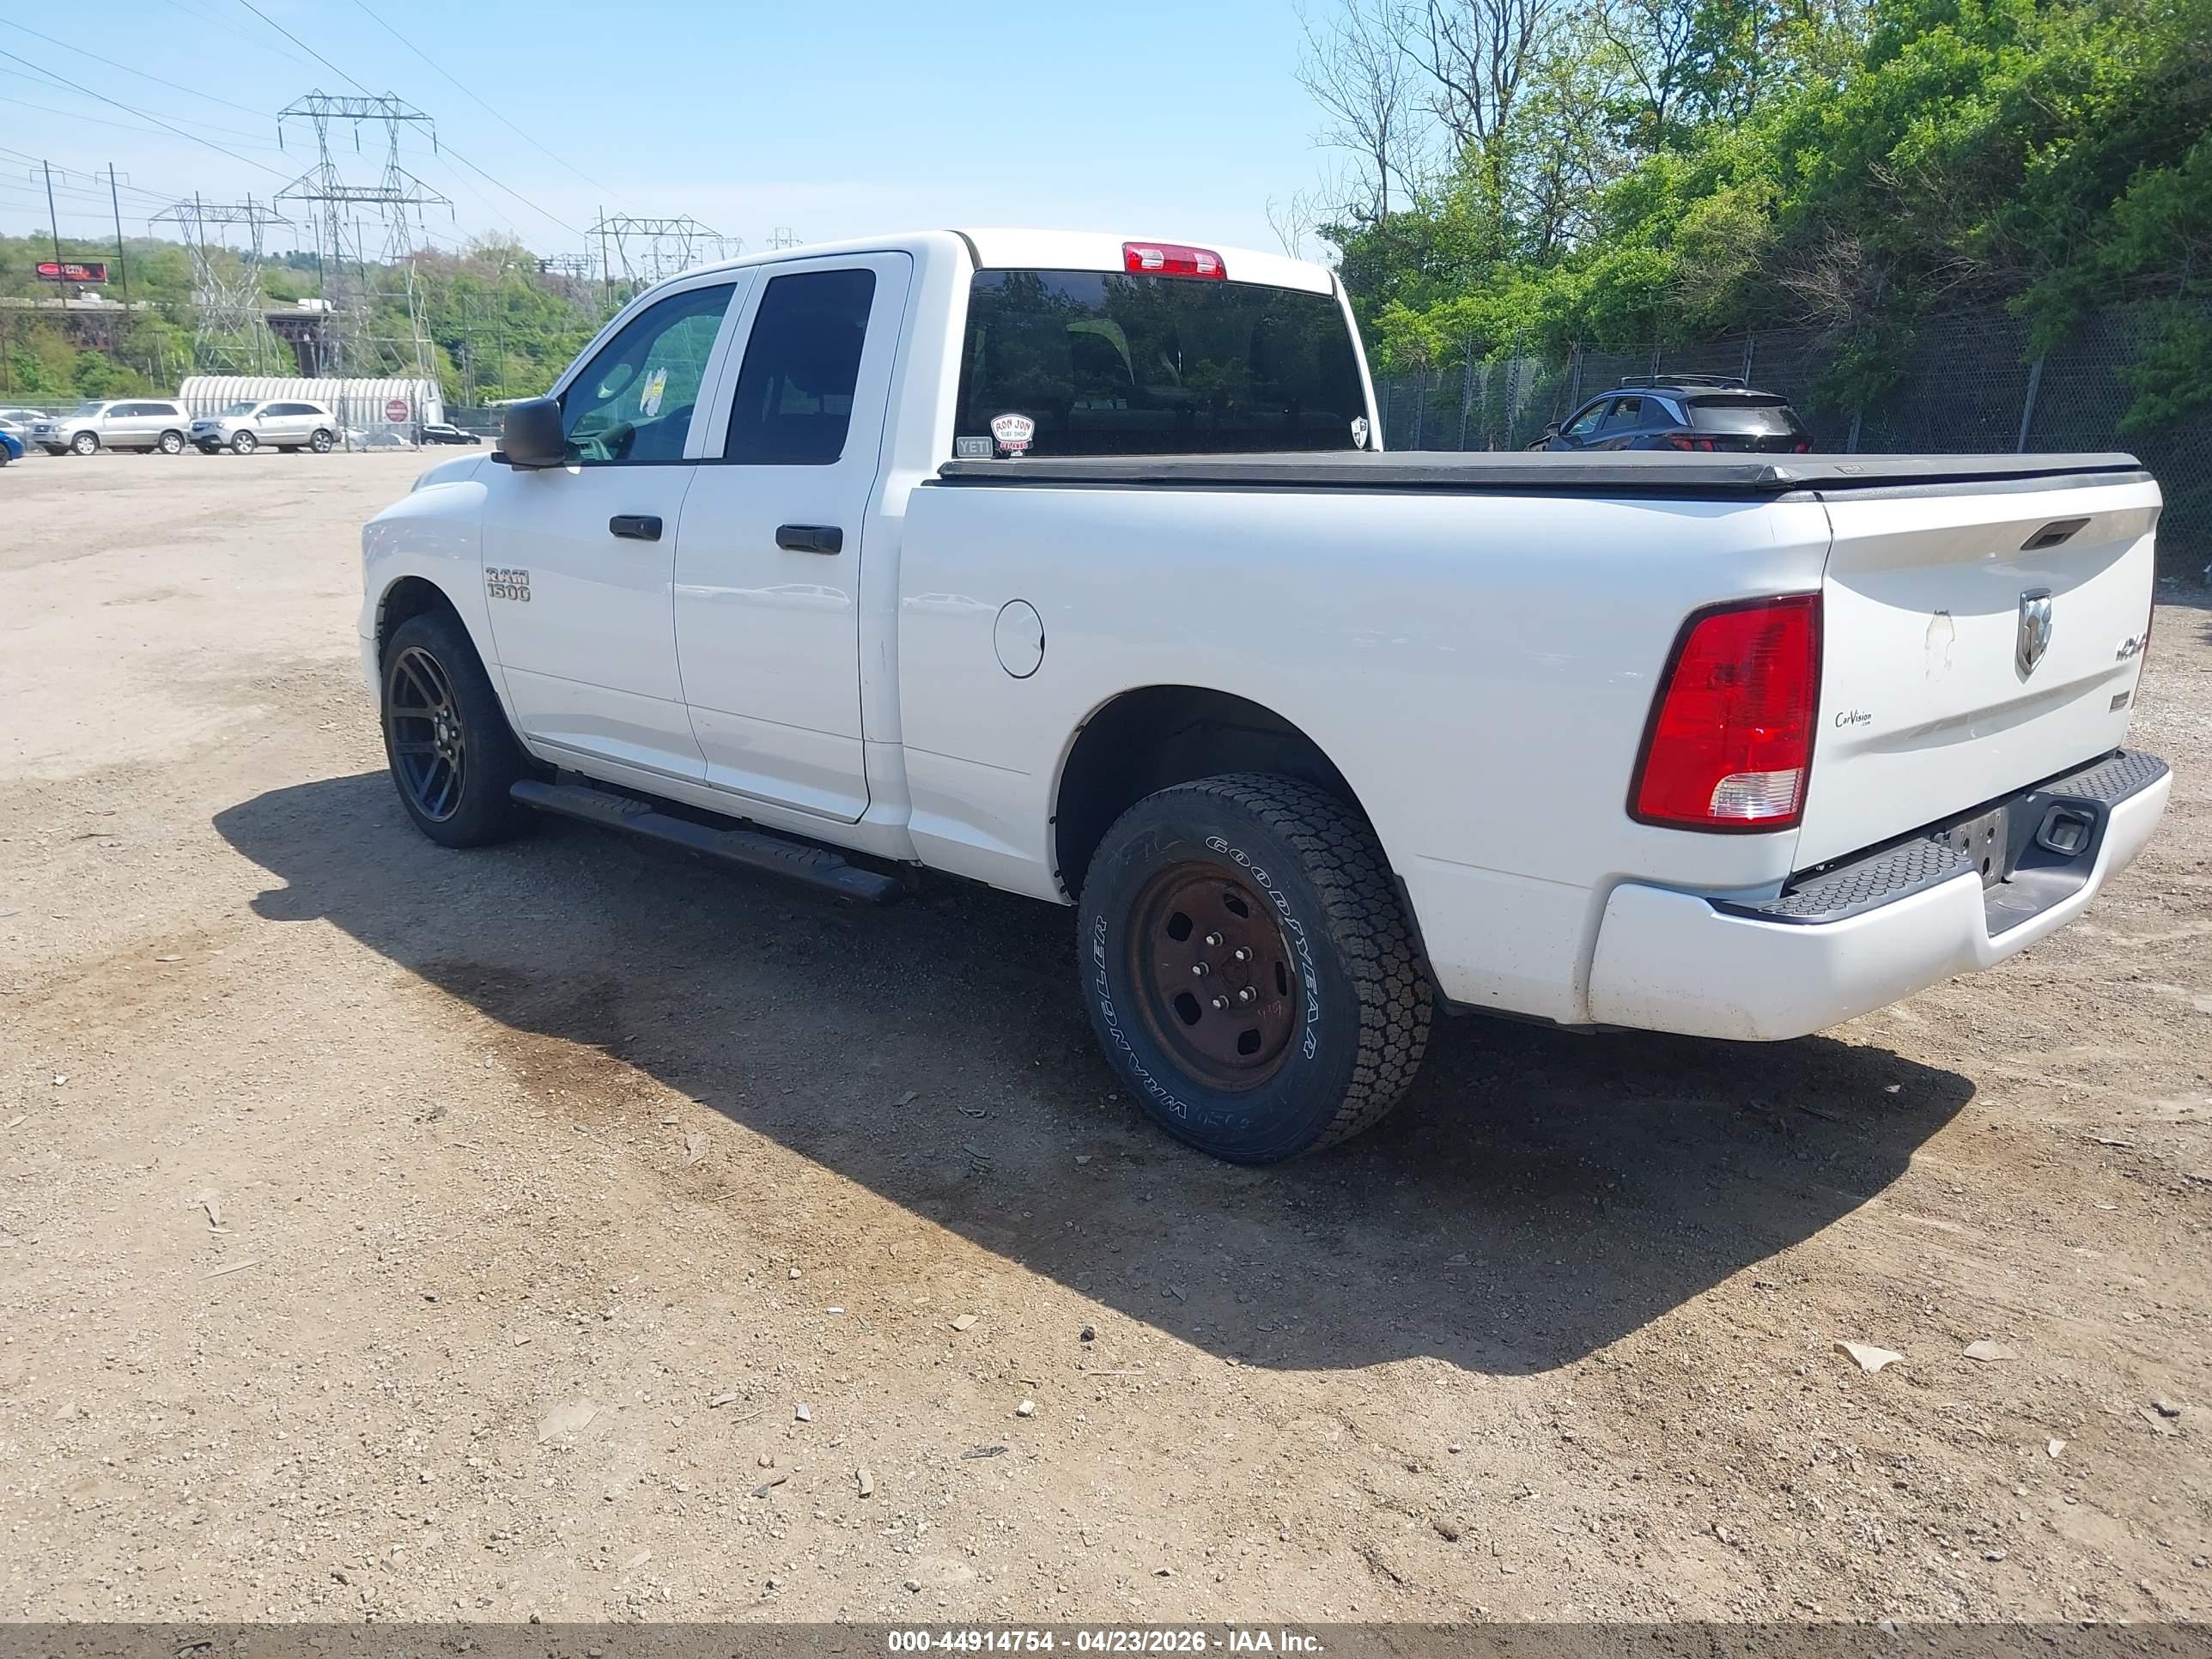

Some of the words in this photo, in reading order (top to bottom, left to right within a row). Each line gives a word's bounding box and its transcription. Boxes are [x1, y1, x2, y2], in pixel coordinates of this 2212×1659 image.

[996, 419, 1012, 432] RON
[1015, 419, 1030, 431] JON
[959, 441, 989, 453] YETI
[486, 567, 530, 586] RAM
[487, 583, 531, 602] 1500
[1835, 709, 1872, 727] CarVision
[1205, 836, 1320, 1060] GOODYEAR
[1092, 915, 1188, 1120] WRANGLER
